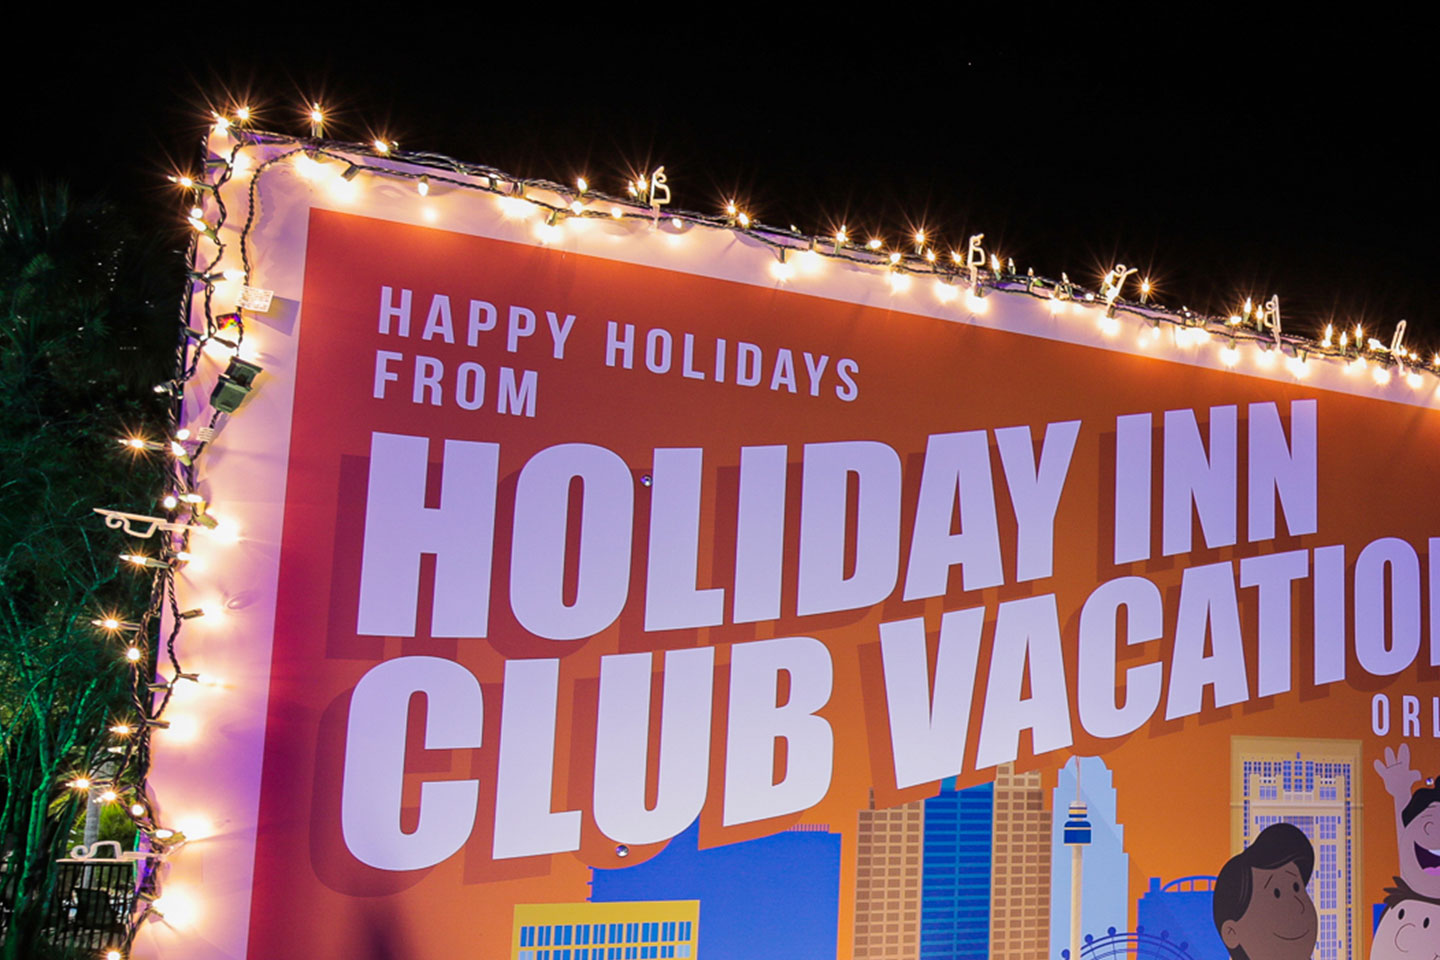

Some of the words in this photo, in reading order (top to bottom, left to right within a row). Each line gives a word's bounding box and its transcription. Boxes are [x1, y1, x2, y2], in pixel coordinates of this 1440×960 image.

[372, 349, 539, 418] FROM
[378, 285, 576, 360] HAPPY
[605, 320, 861, 403] HOLIDAYS
[356, 419, 1082, 641] HOLIDAY
[1114, 399, 1318, 565] INN
[341, 635, 835, 872] CLUB
